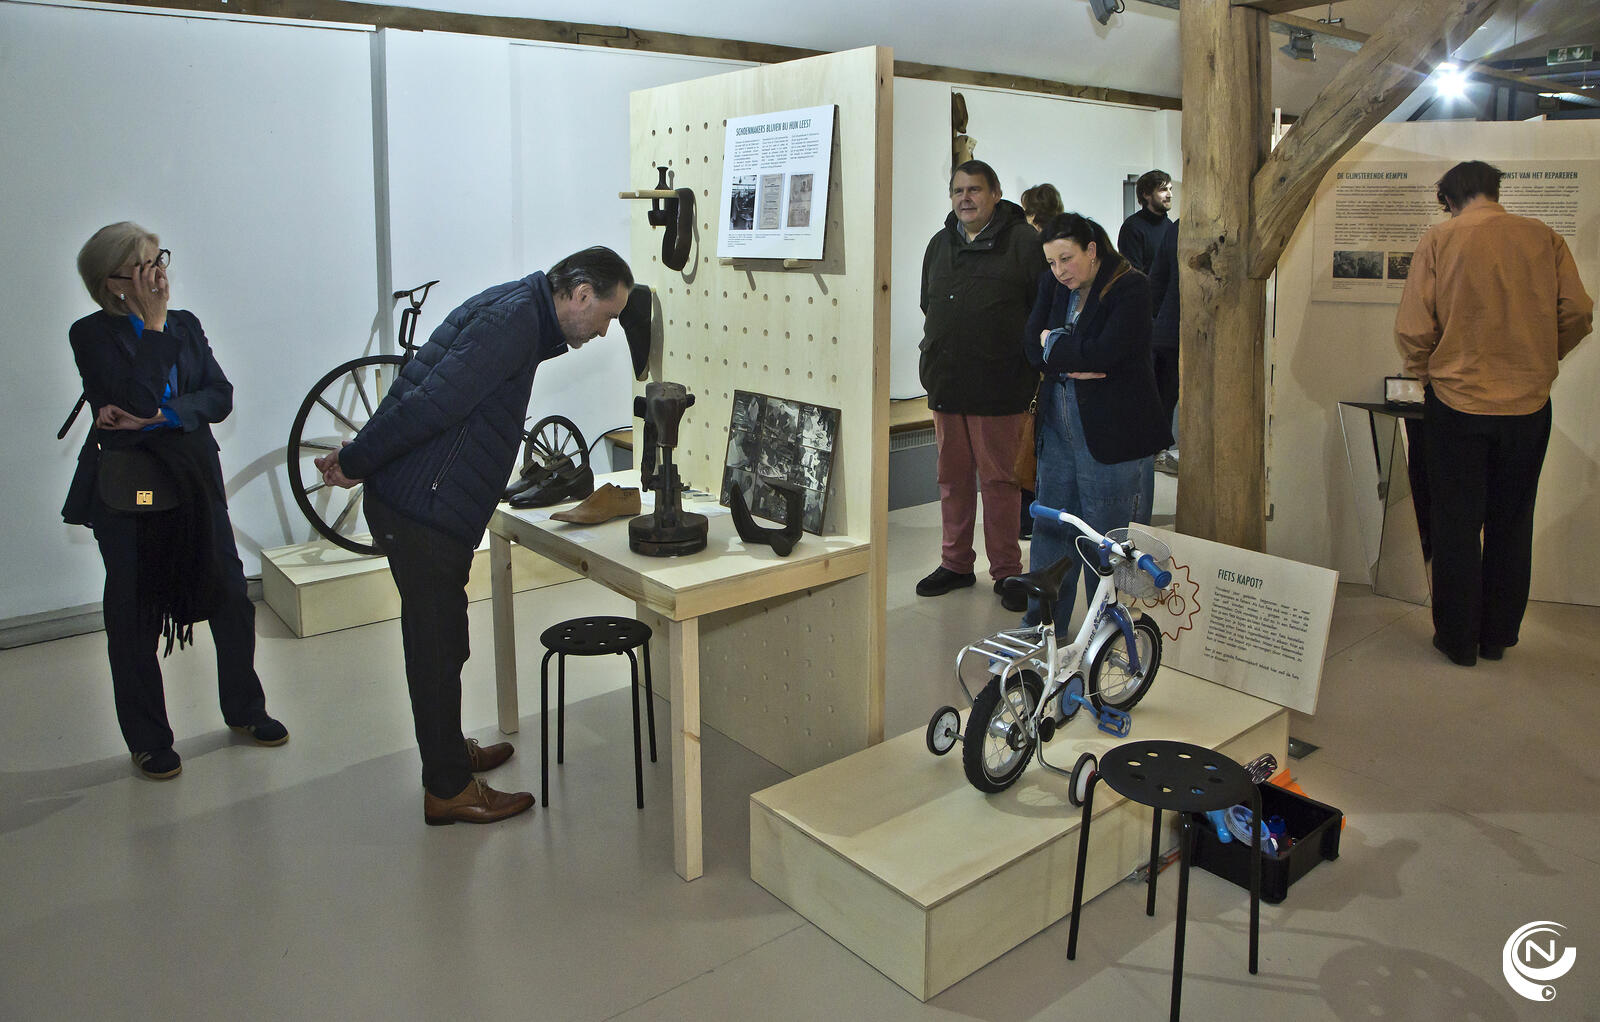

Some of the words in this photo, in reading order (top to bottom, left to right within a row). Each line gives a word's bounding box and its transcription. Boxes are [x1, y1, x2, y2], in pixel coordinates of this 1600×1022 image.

[736, 124, 766, 136] SCHOENMAKERS
[789, 120, 799, 130] HUN
[799, 119, 812, 128] LEEST
[1520, 171, 1531, 179] VAN
[1532, 171, 1543, 179] HET
[1544, 171, 1578, 179] REPAREREN
[1217, 568, 1235, 582] FIETS
[1236, 573, 1263, 589] KAPOT?
